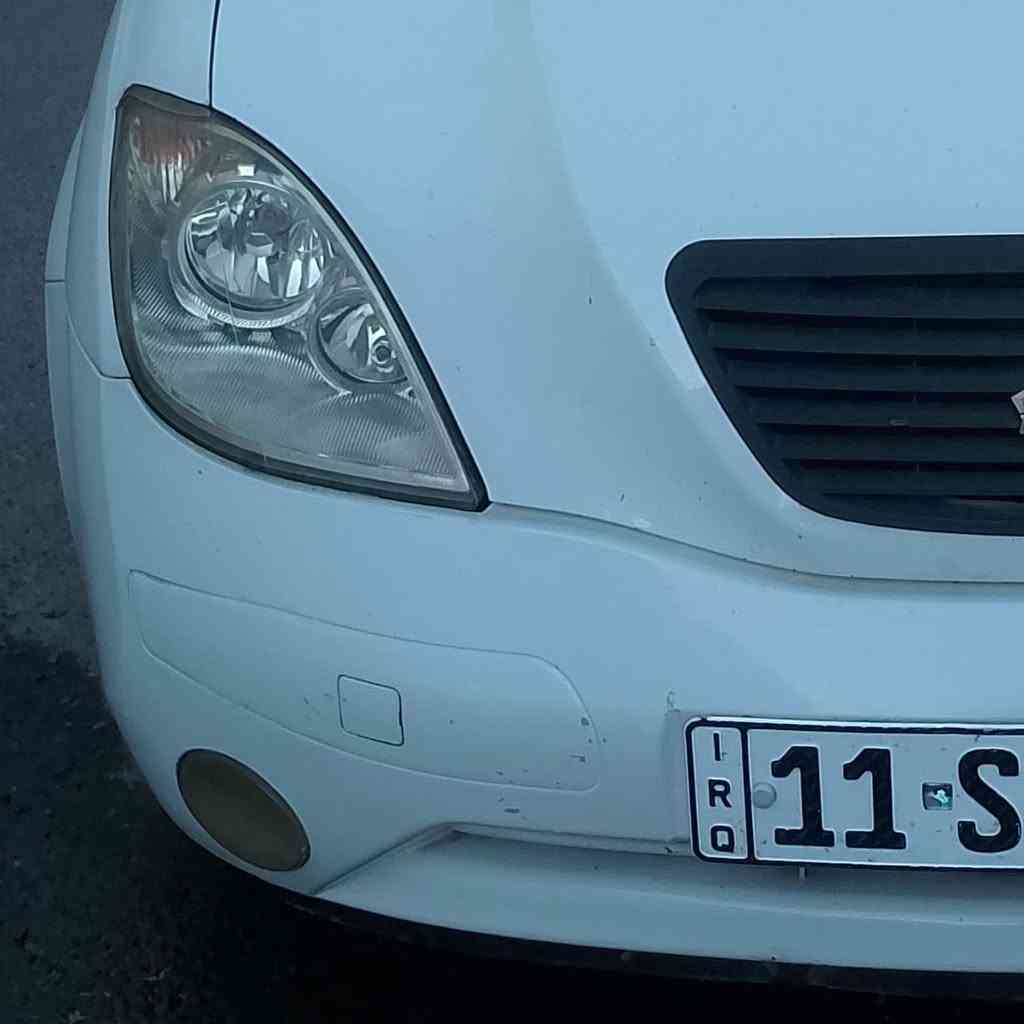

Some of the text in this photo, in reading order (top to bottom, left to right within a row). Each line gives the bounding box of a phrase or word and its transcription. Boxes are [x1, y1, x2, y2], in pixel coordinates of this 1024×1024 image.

[708, 732, 736, 854] IRQ
[769, 745, 908, 852] 11
[955, 747, 1023, 855] S
